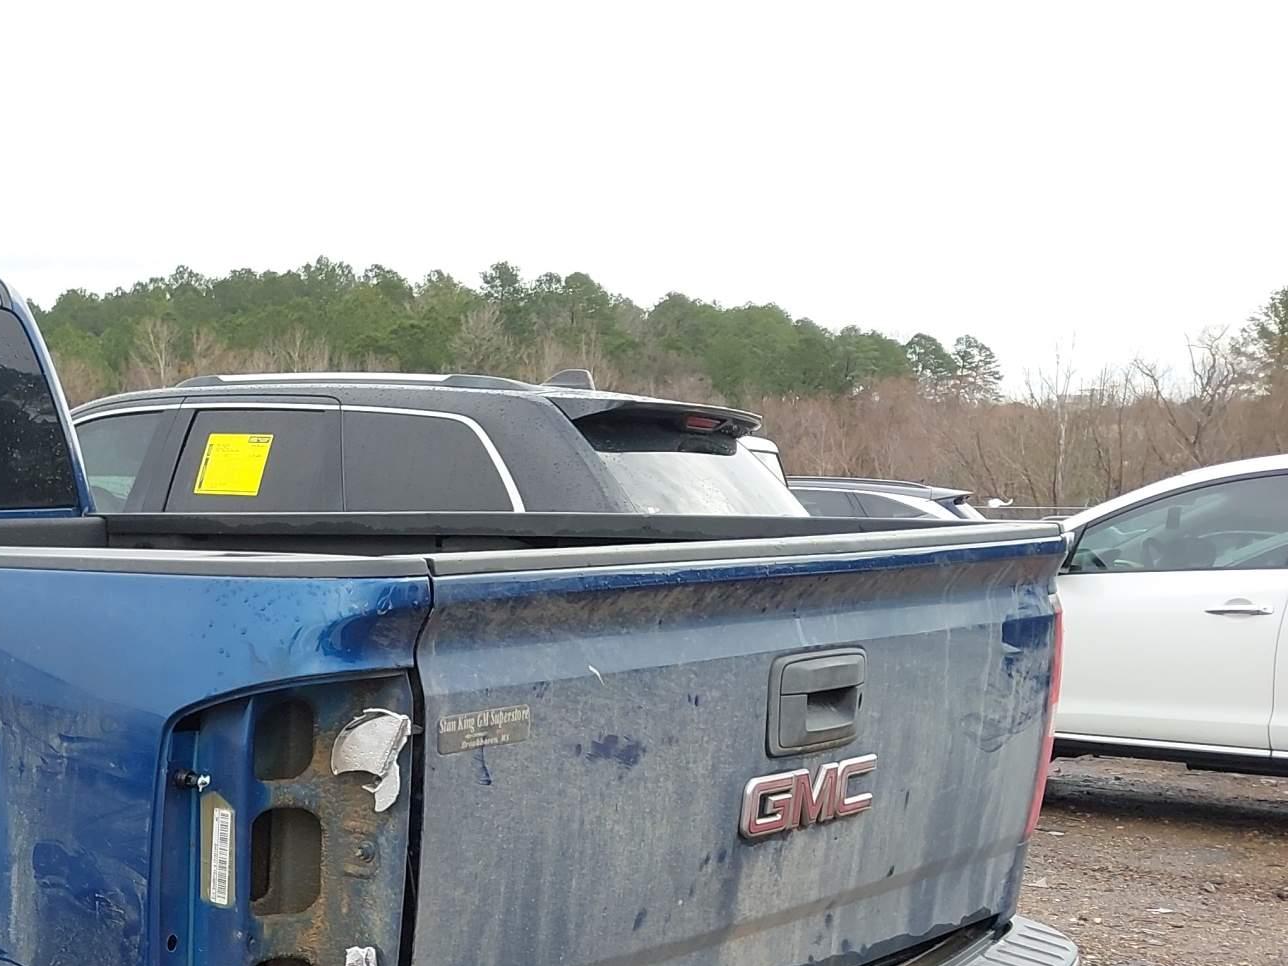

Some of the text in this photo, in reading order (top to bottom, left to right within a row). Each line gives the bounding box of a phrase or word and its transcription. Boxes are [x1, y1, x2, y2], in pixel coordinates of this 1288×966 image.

[439, 707, 529, 734] Stan King GM Superstore
[739, 753, 878, 837] GMC
